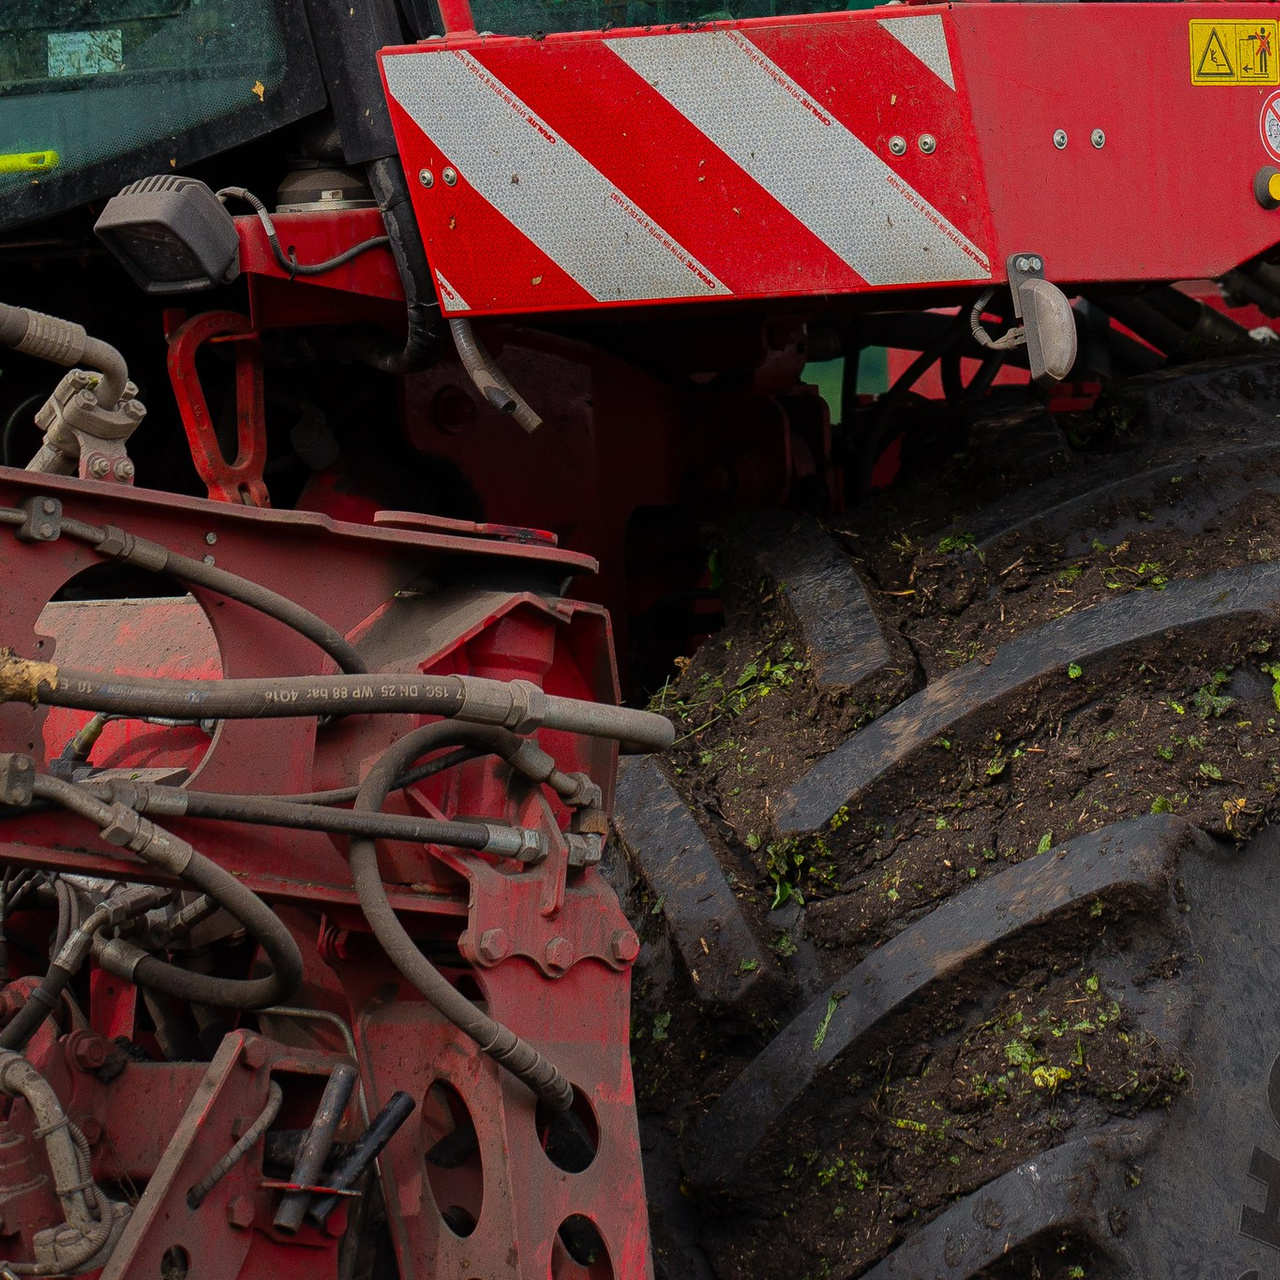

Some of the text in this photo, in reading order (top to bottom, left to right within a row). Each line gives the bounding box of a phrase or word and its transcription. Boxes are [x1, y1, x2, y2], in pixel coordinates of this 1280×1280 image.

[800, 98, 831, 127] ORALITE
[526, 116, 557, 144] ORALITE
[962, 244, 992, 273] ORALITE
[686, 261, 716, 288] ORALITE
[306, 686, 329, 699] bar
[333, 686, 347, 699] 88
[352, 685, 374, 698] WP
[381, 684, 396, 697] 25
[400, 684, 419, 697] DN
